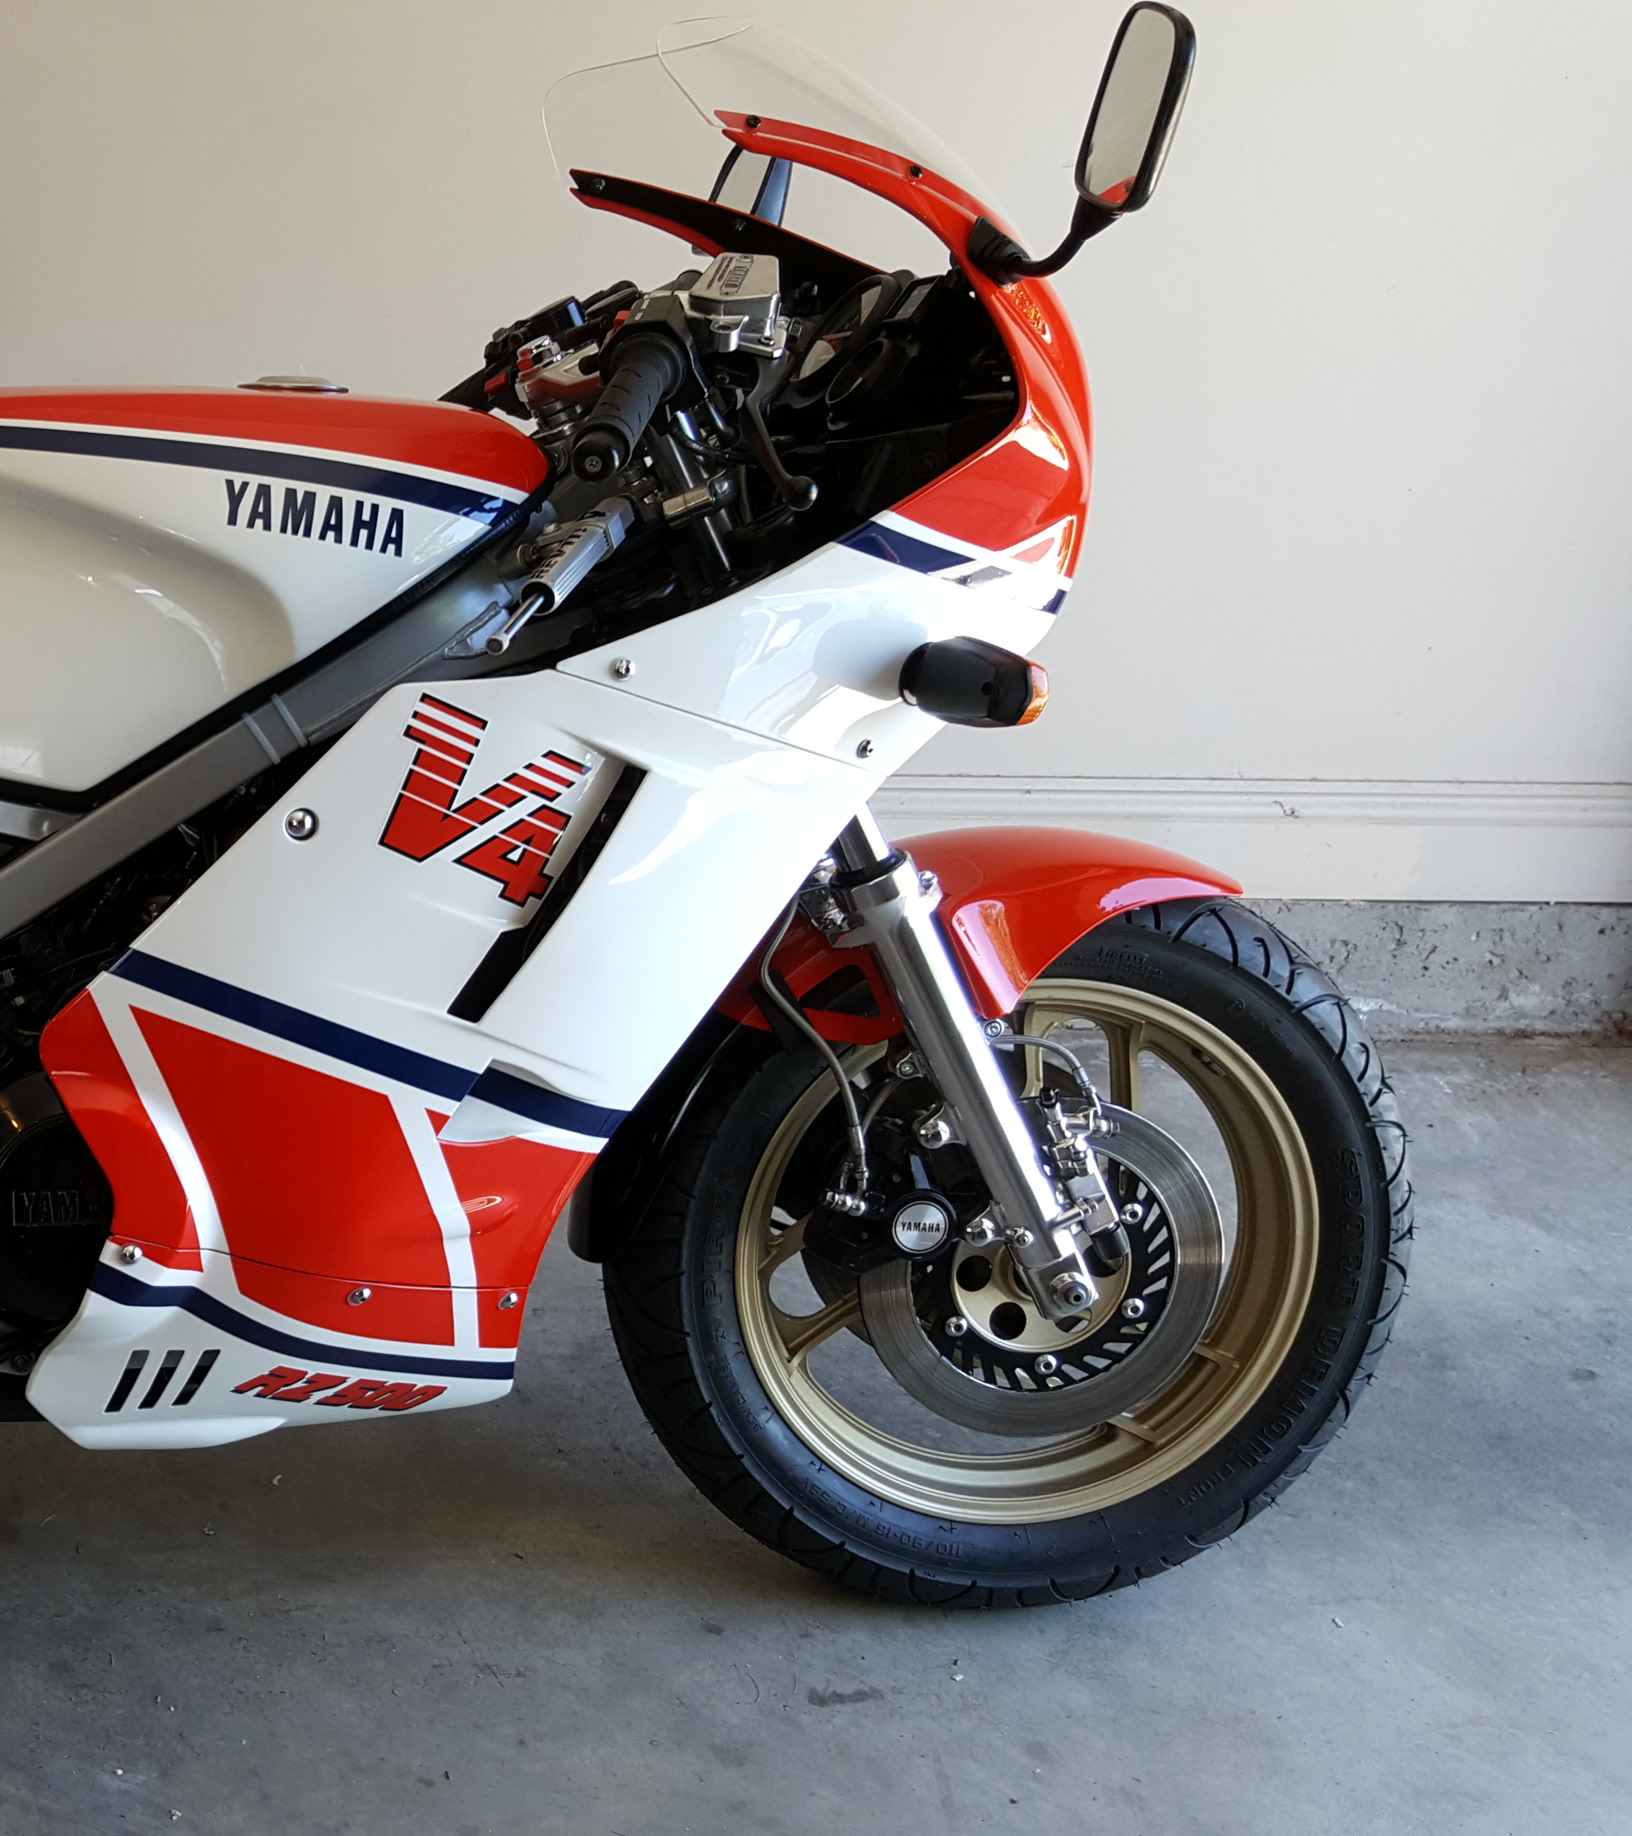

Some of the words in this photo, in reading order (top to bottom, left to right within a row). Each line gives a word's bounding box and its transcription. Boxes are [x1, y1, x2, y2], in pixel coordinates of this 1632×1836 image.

[225, 479, 404, 557] YAMAHA
[378, 692, 592, 907] V4
[901, 1221, 940, 1233] YAMAHA
[1332, 1147, 1367, 1306] SPORT
[1237, 1326, 1345, 1469] DEMON
[1177, 1463, 1235, 1506] FRONT
